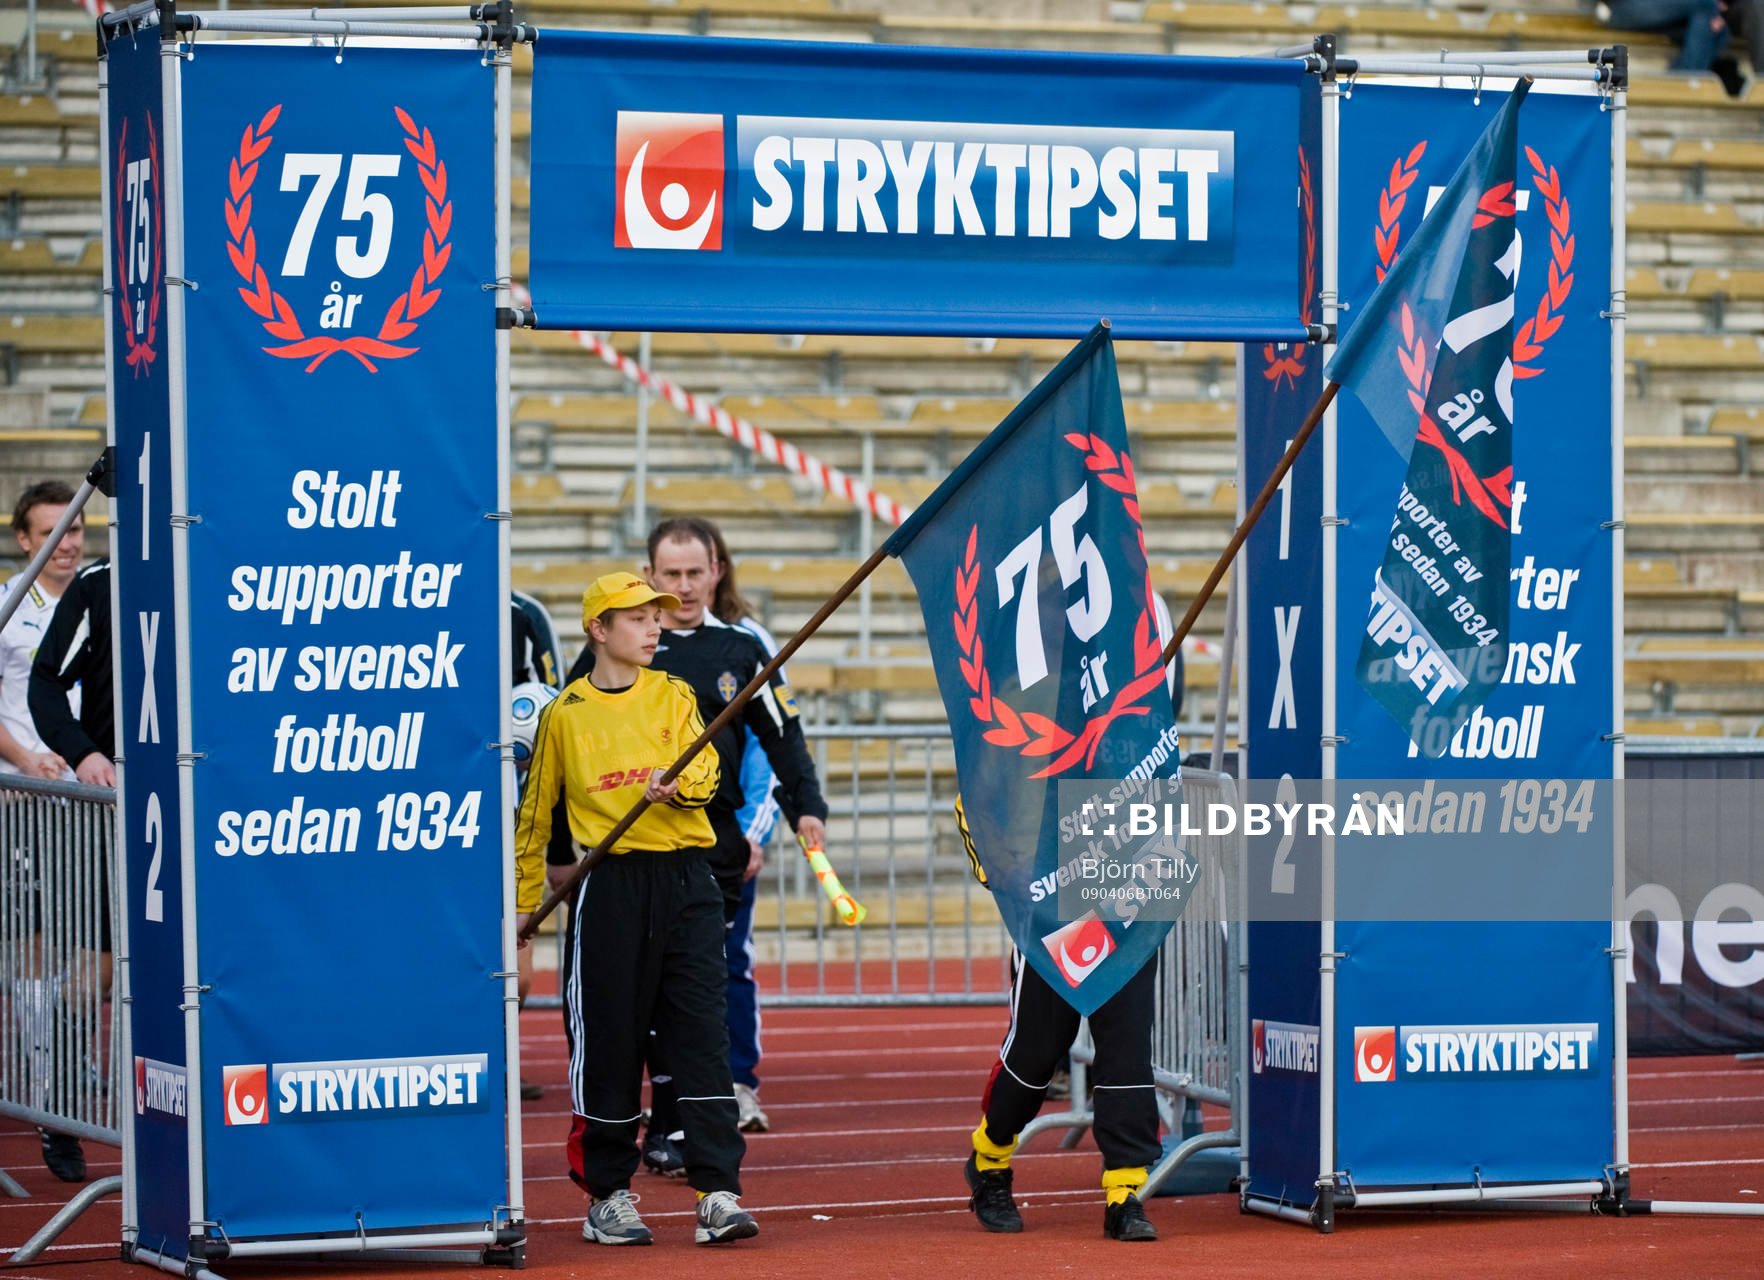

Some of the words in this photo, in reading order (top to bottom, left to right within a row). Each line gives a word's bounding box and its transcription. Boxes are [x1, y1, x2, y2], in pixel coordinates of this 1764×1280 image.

[279, 153, 402, 279] 75
[752, 135, 1219, 242] STRYKTIPSET
[127, 158, 150, 286] 75
[136, 290, 146, 334] år
[319, 281, 363, 329] år
[1437, 388, 1498, 443] år
[138, 432, 150, 560] 1
[287, 470, 402, 529] Stolt
[228, 551, 462, 625] supporter
[995, 480, 1113, 692] 75
[1391, 532, 1450, 597] sedan
[1447, 594, 1500, 648] 1934
[1453, 555, 1484, 584] av
[227, 647, 287, 693] av
[294, 631, 466, 692] svensk
[1367, 568, 1458, 706] TIPSET
[1080, 650, 1110, 715] år
[273, 712, 425, 773] fotboll
[597, 767, 653, 793] DH
[1500, 779, 1596, 834] 1934
[215, 796, 361, 857] sedan
[375, 790, 483, 851] 1934
[144, 792, 164, 923] 2
[1029, 840, 1110, 902] svensk
[1265, 1029, 1319, 1073] STRYKTIPSET
[1405, 1030, 1593, 1073] STRYKTIPSET
[146, 1067, 186, 1117] STRYKTIPSET
[279, 1062, 482, 1115] STRYKTIPSET
